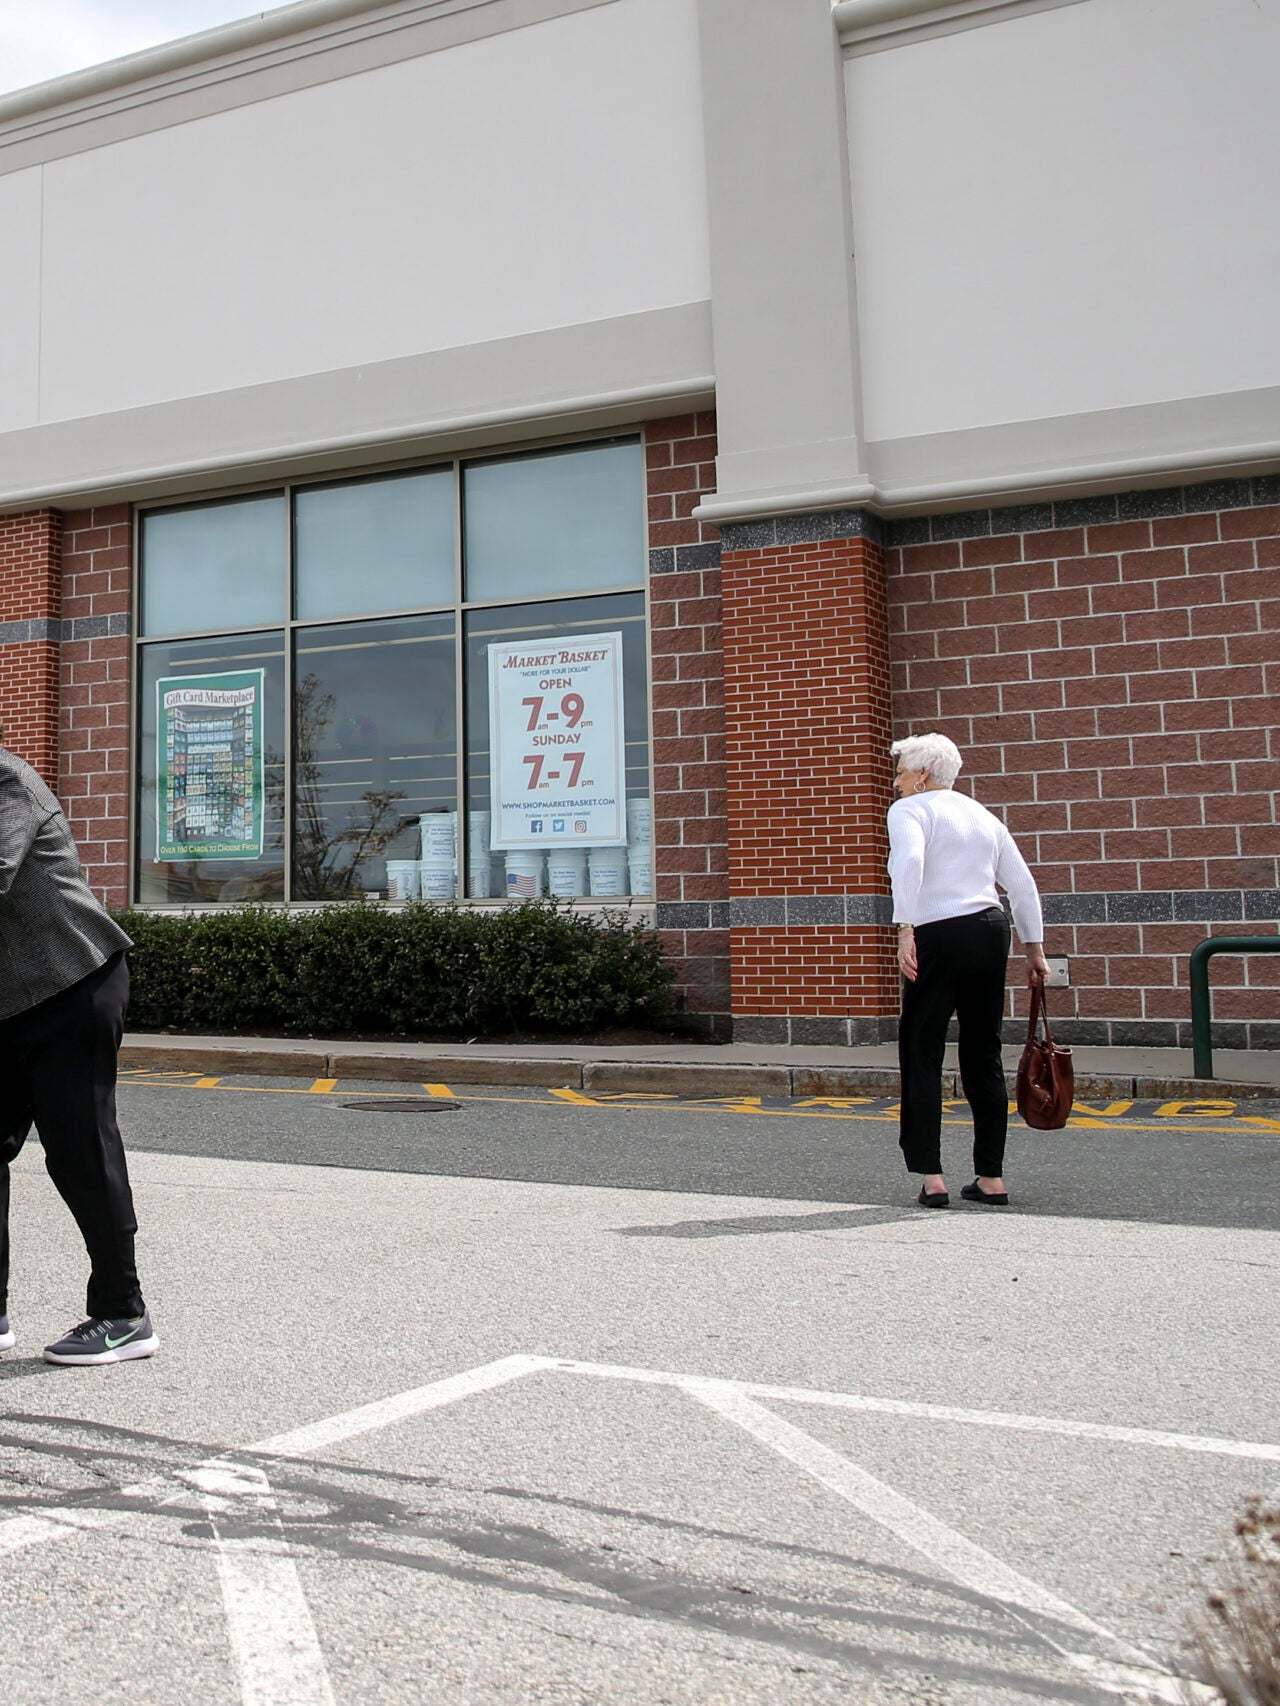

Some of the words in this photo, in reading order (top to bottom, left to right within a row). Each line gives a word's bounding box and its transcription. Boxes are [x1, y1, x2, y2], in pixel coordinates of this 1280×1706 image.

[503, 655, 557, 669] MARKET
[558, 650, 608, 664] BASKET
[551, 667, 566, 675] YOUR
[539, 677, 572, 690] OPEN
[166, 693, 181, 706] Gift
[183, 691, 203, 702] Card
[205, 690, 253, 707] Marketplace
[532, 733, 581, 746] SUNDAY
[502, 798, 615, 809] WWW.SHOPMARKETBASKET.COM
